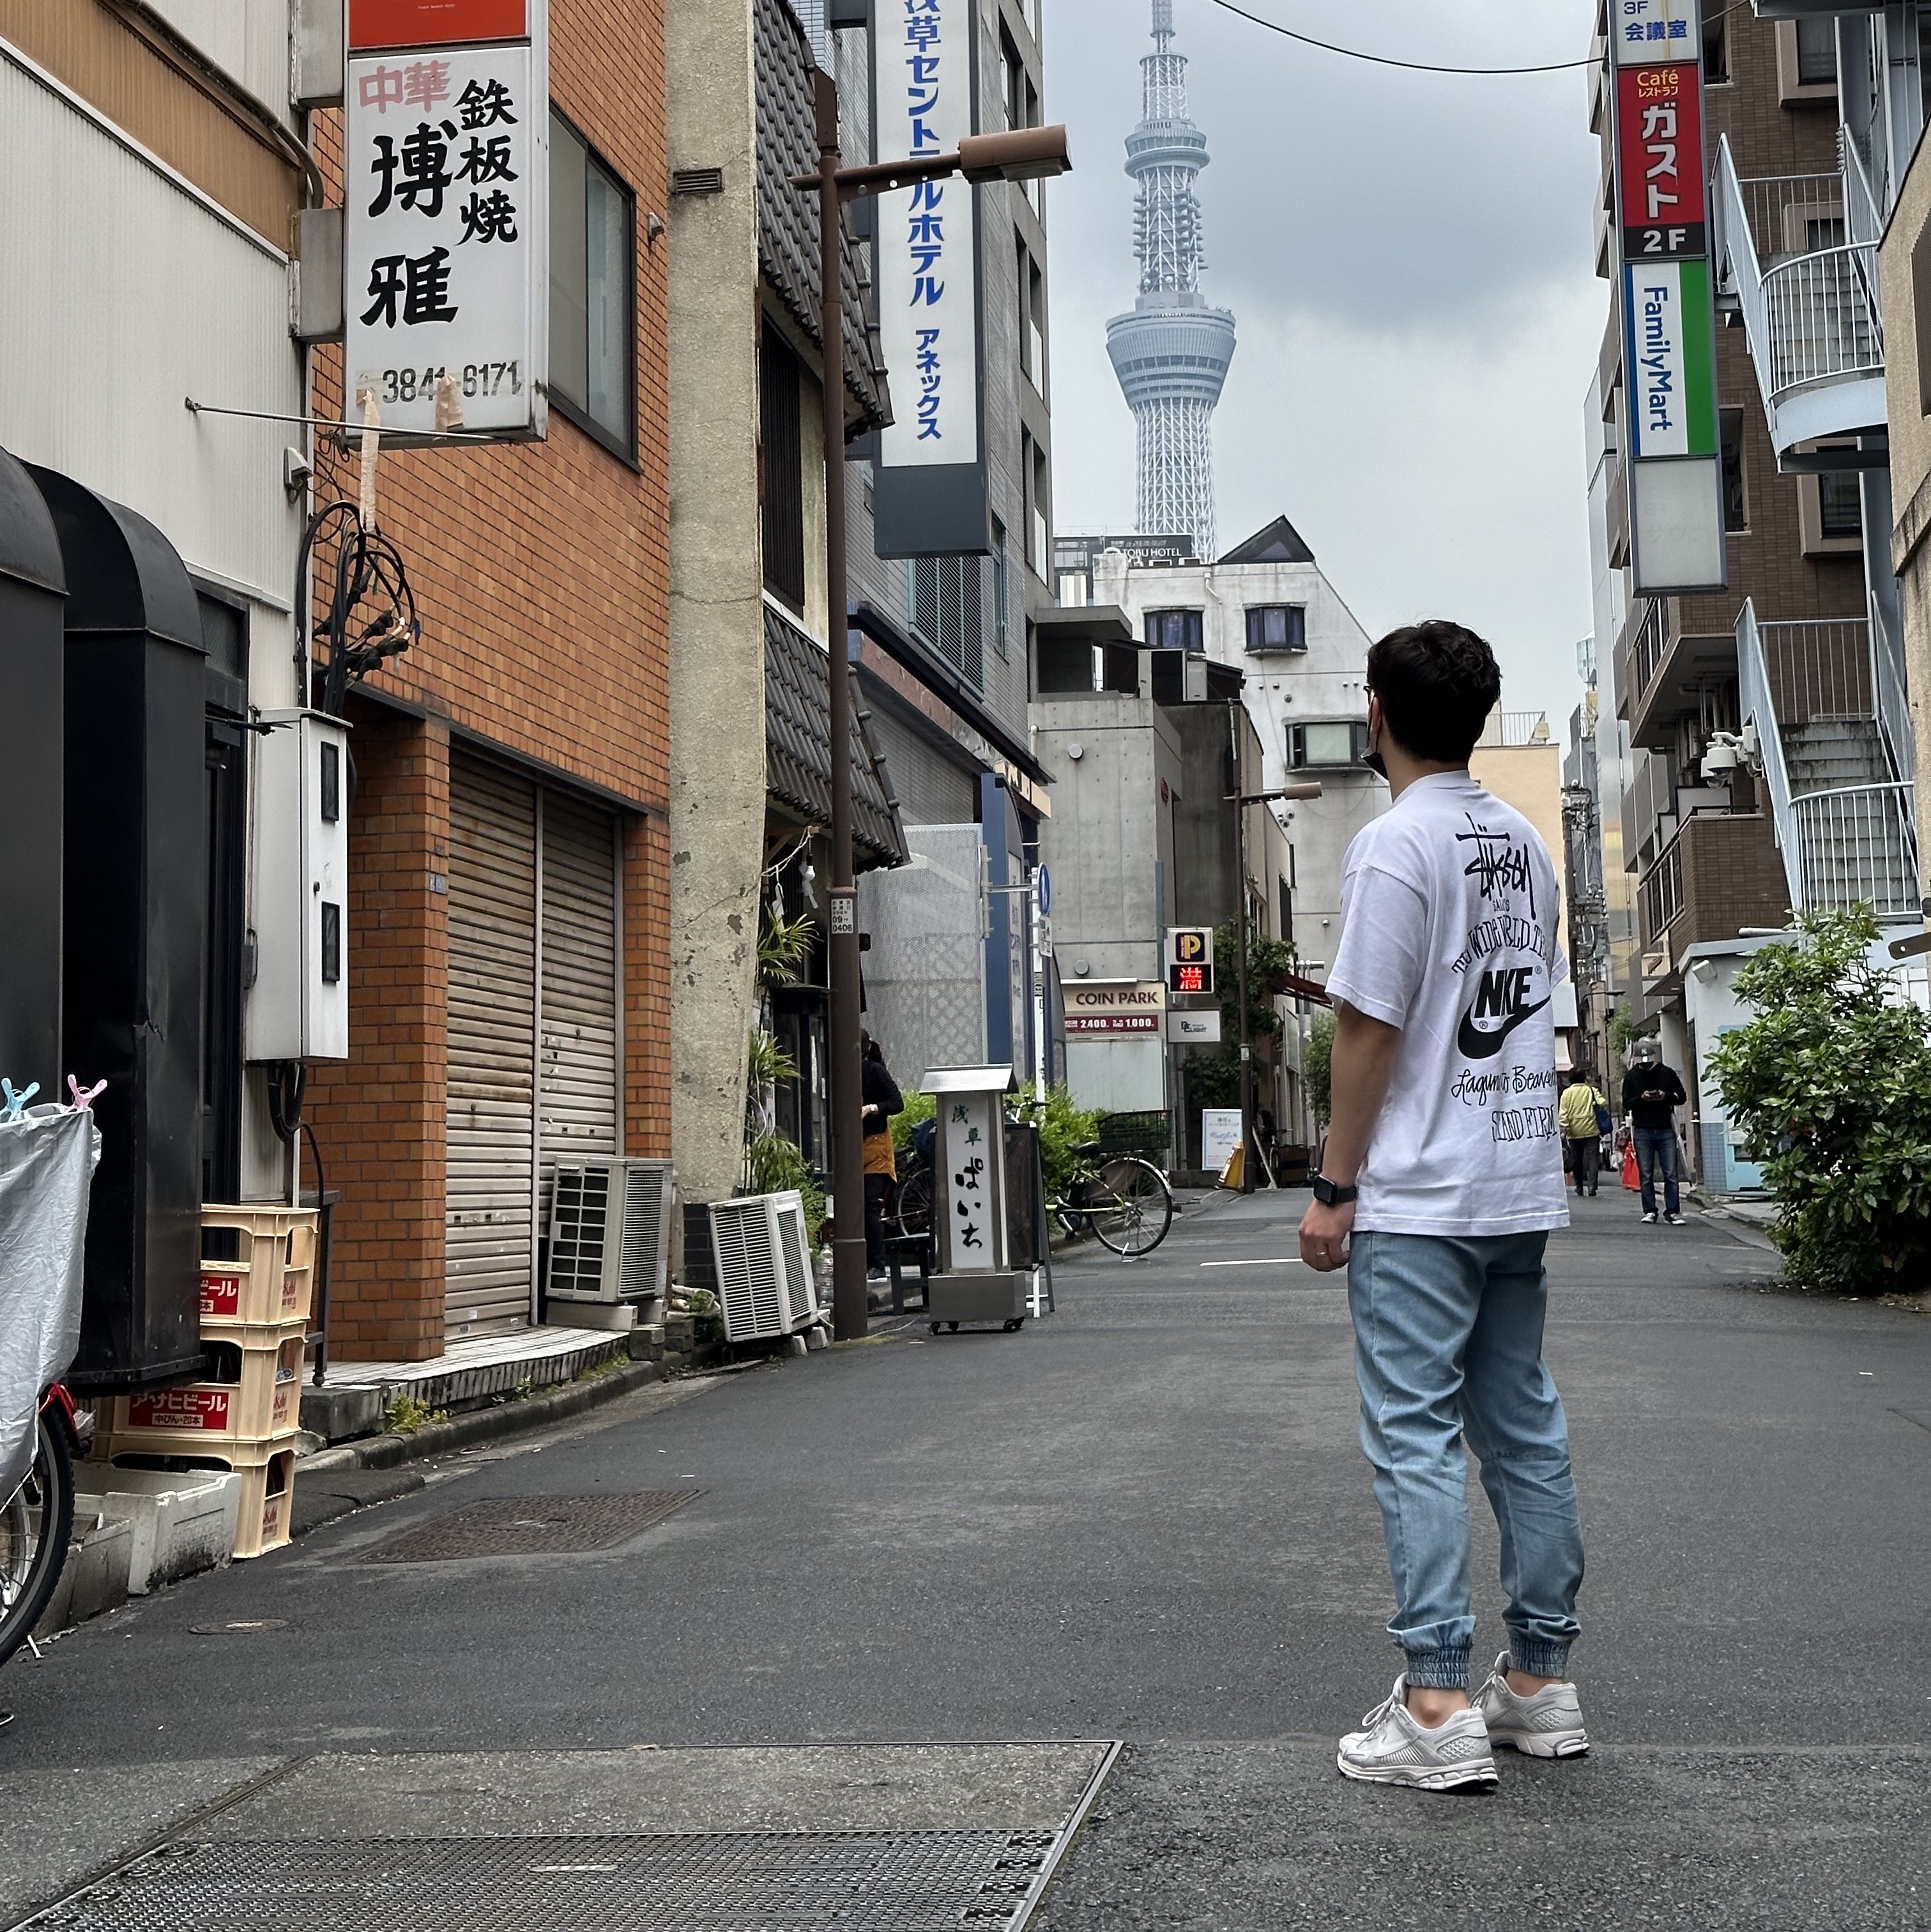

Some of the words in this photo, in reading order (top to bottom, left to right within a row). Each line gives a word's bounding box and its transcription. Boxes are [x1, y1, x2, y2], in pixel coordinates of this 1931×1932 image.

[1624, 1, 1648, 15] 3F
[1625, 19, 1688, 42] 会議室
[359, 60, 451, 114] 中華
[1637, 69, 1679, 86] Café
[1638, 86, 1679, 98] レストラン
[454, 79, 519, 246] 鉄板焼
[904, 0, 945, 307] 草セントルホテル
[1642, 101, 1678, 218] ガスト
[1643, 229, 1686, 253] 2F
[1640, 286, 1674, 431] FamilyMart
[915, 328, 943, 441] アネックス
[1122, 548, 1149, 557] TOBU
[1150, 548, 1182, 557] HOTEL
[1179, 967, 1202, 990] 満
[1474, 967, 1533, 1018] NKE
[1076, 992, 1114, 1006] COIN
[1118, 991, 1159, 1005] PARK
[951, 1105, 982, 1147] 浅草
[954, 1156, 984, 1250] ぱいち
[132, 1393, 227, 1412] アサヒビール
